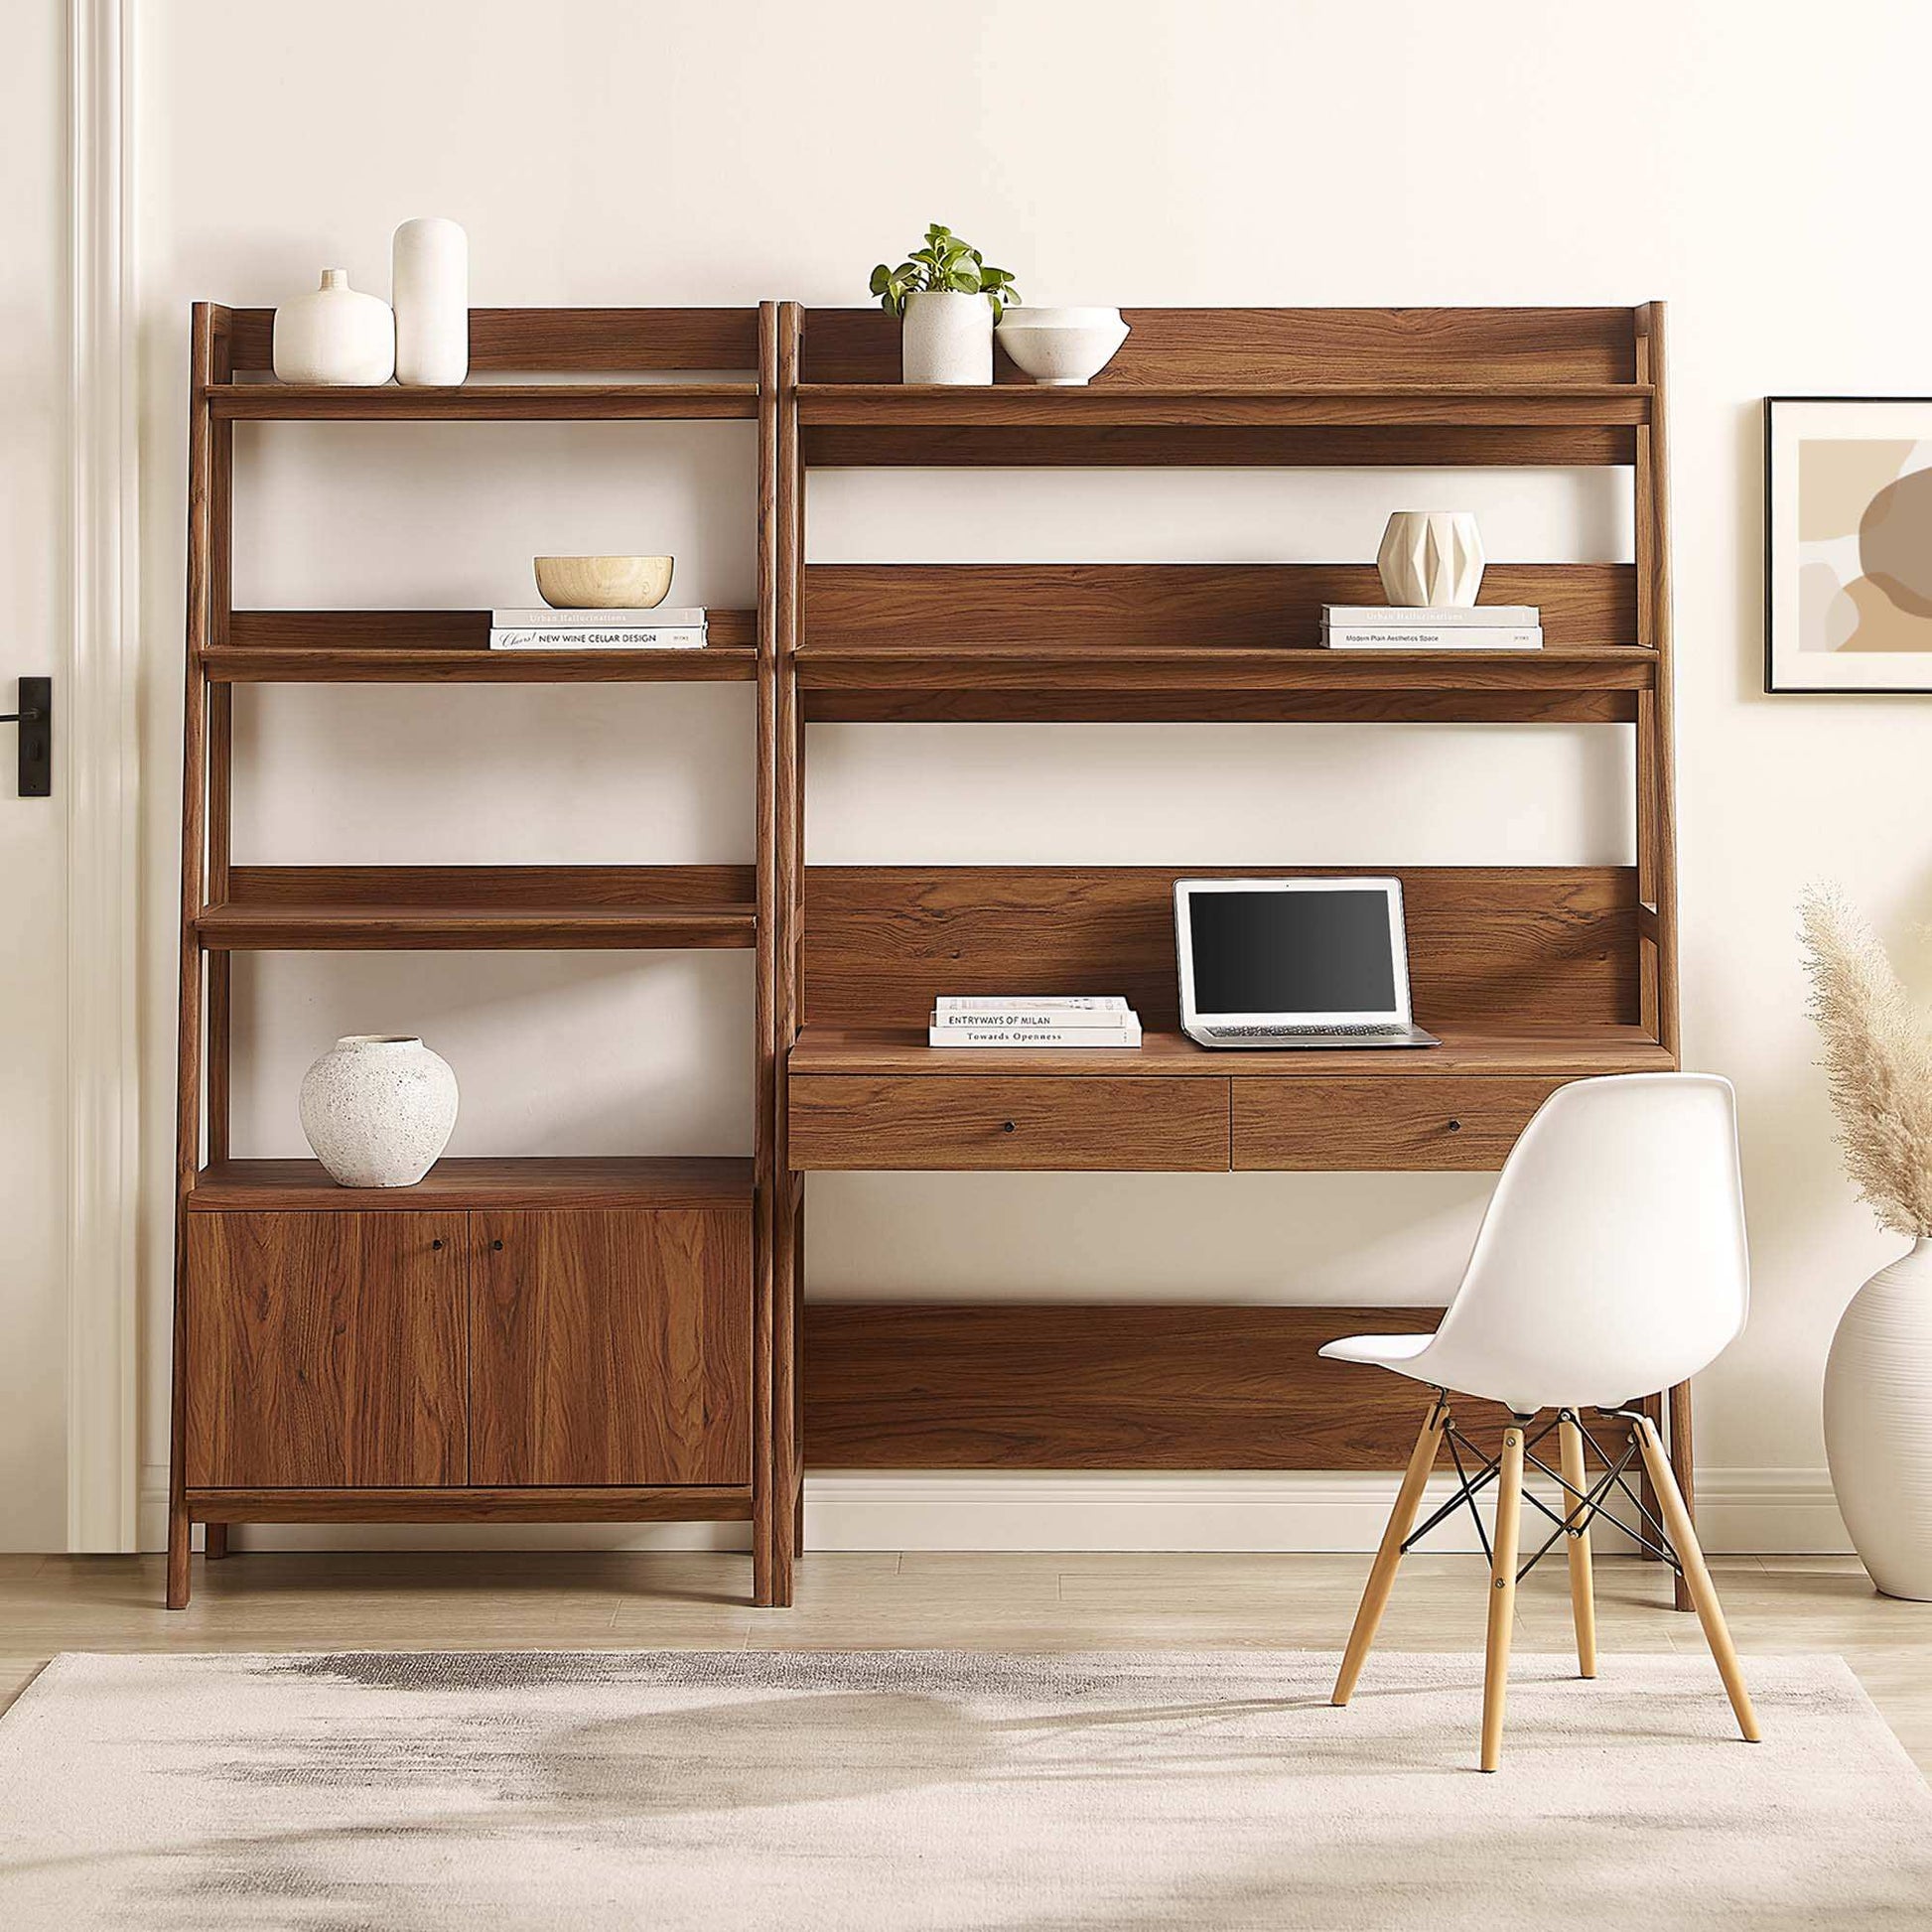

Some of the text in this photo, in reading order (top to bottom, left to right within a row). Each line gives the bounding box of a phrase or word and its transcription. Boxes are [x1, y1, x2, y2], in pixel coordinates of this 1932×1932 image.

[562, 634, 586, 643] WINE
[588, 634, 621, 643] CELLAR
[621, 634, 656, 643] DESIGN
[948, 1016, 1050, 1025] ENTRYWAYS OF MILAN
[1013, 1033, 1061, 1041] Openness
